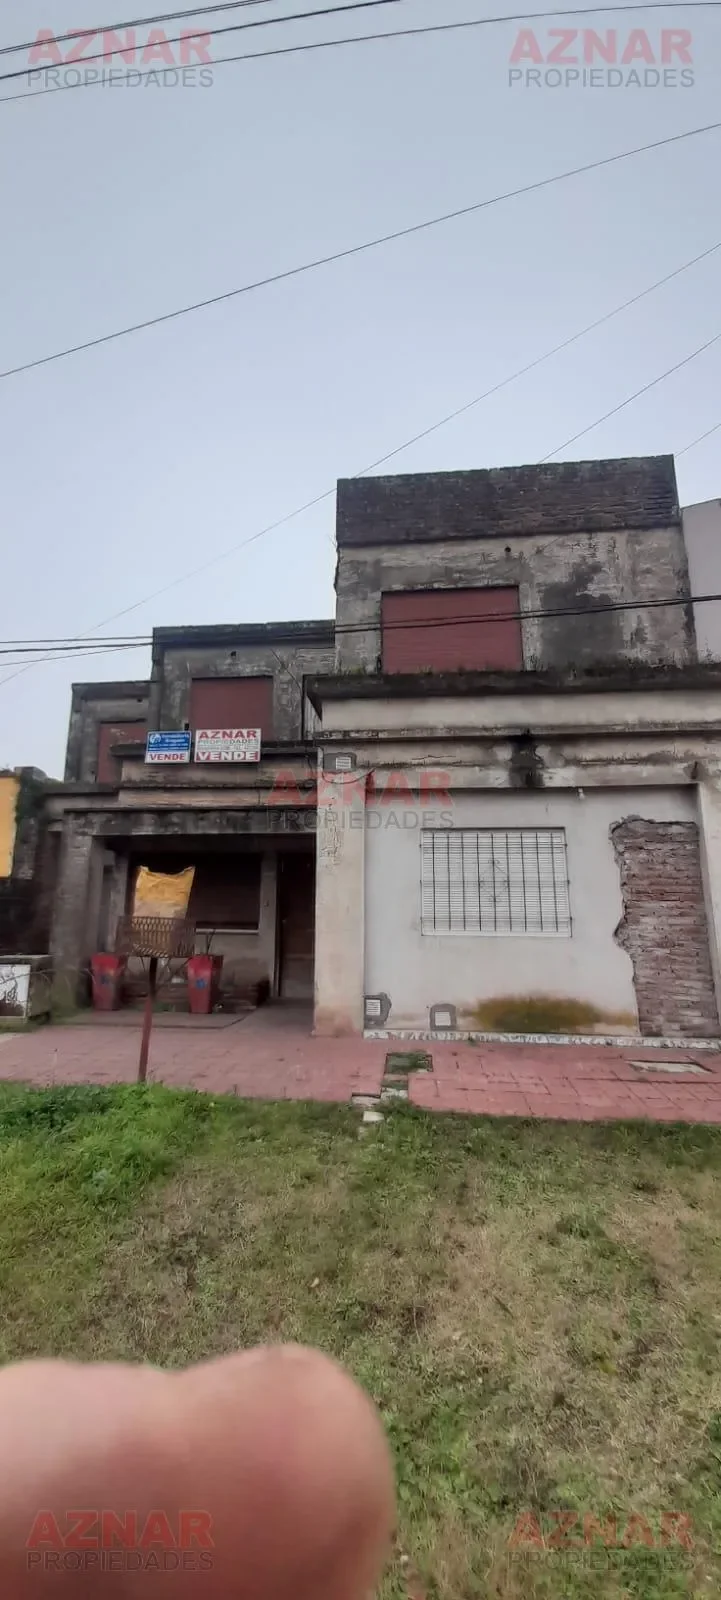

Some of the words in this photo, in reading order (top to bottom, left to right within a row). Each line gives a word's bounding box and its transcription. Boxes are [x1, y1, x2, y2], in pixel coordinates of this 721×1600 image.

[199, 730, 257, 739] AZNAR
[151, 753, 185, 761] VENDE
[197, 751, 256, 761] VENDE
